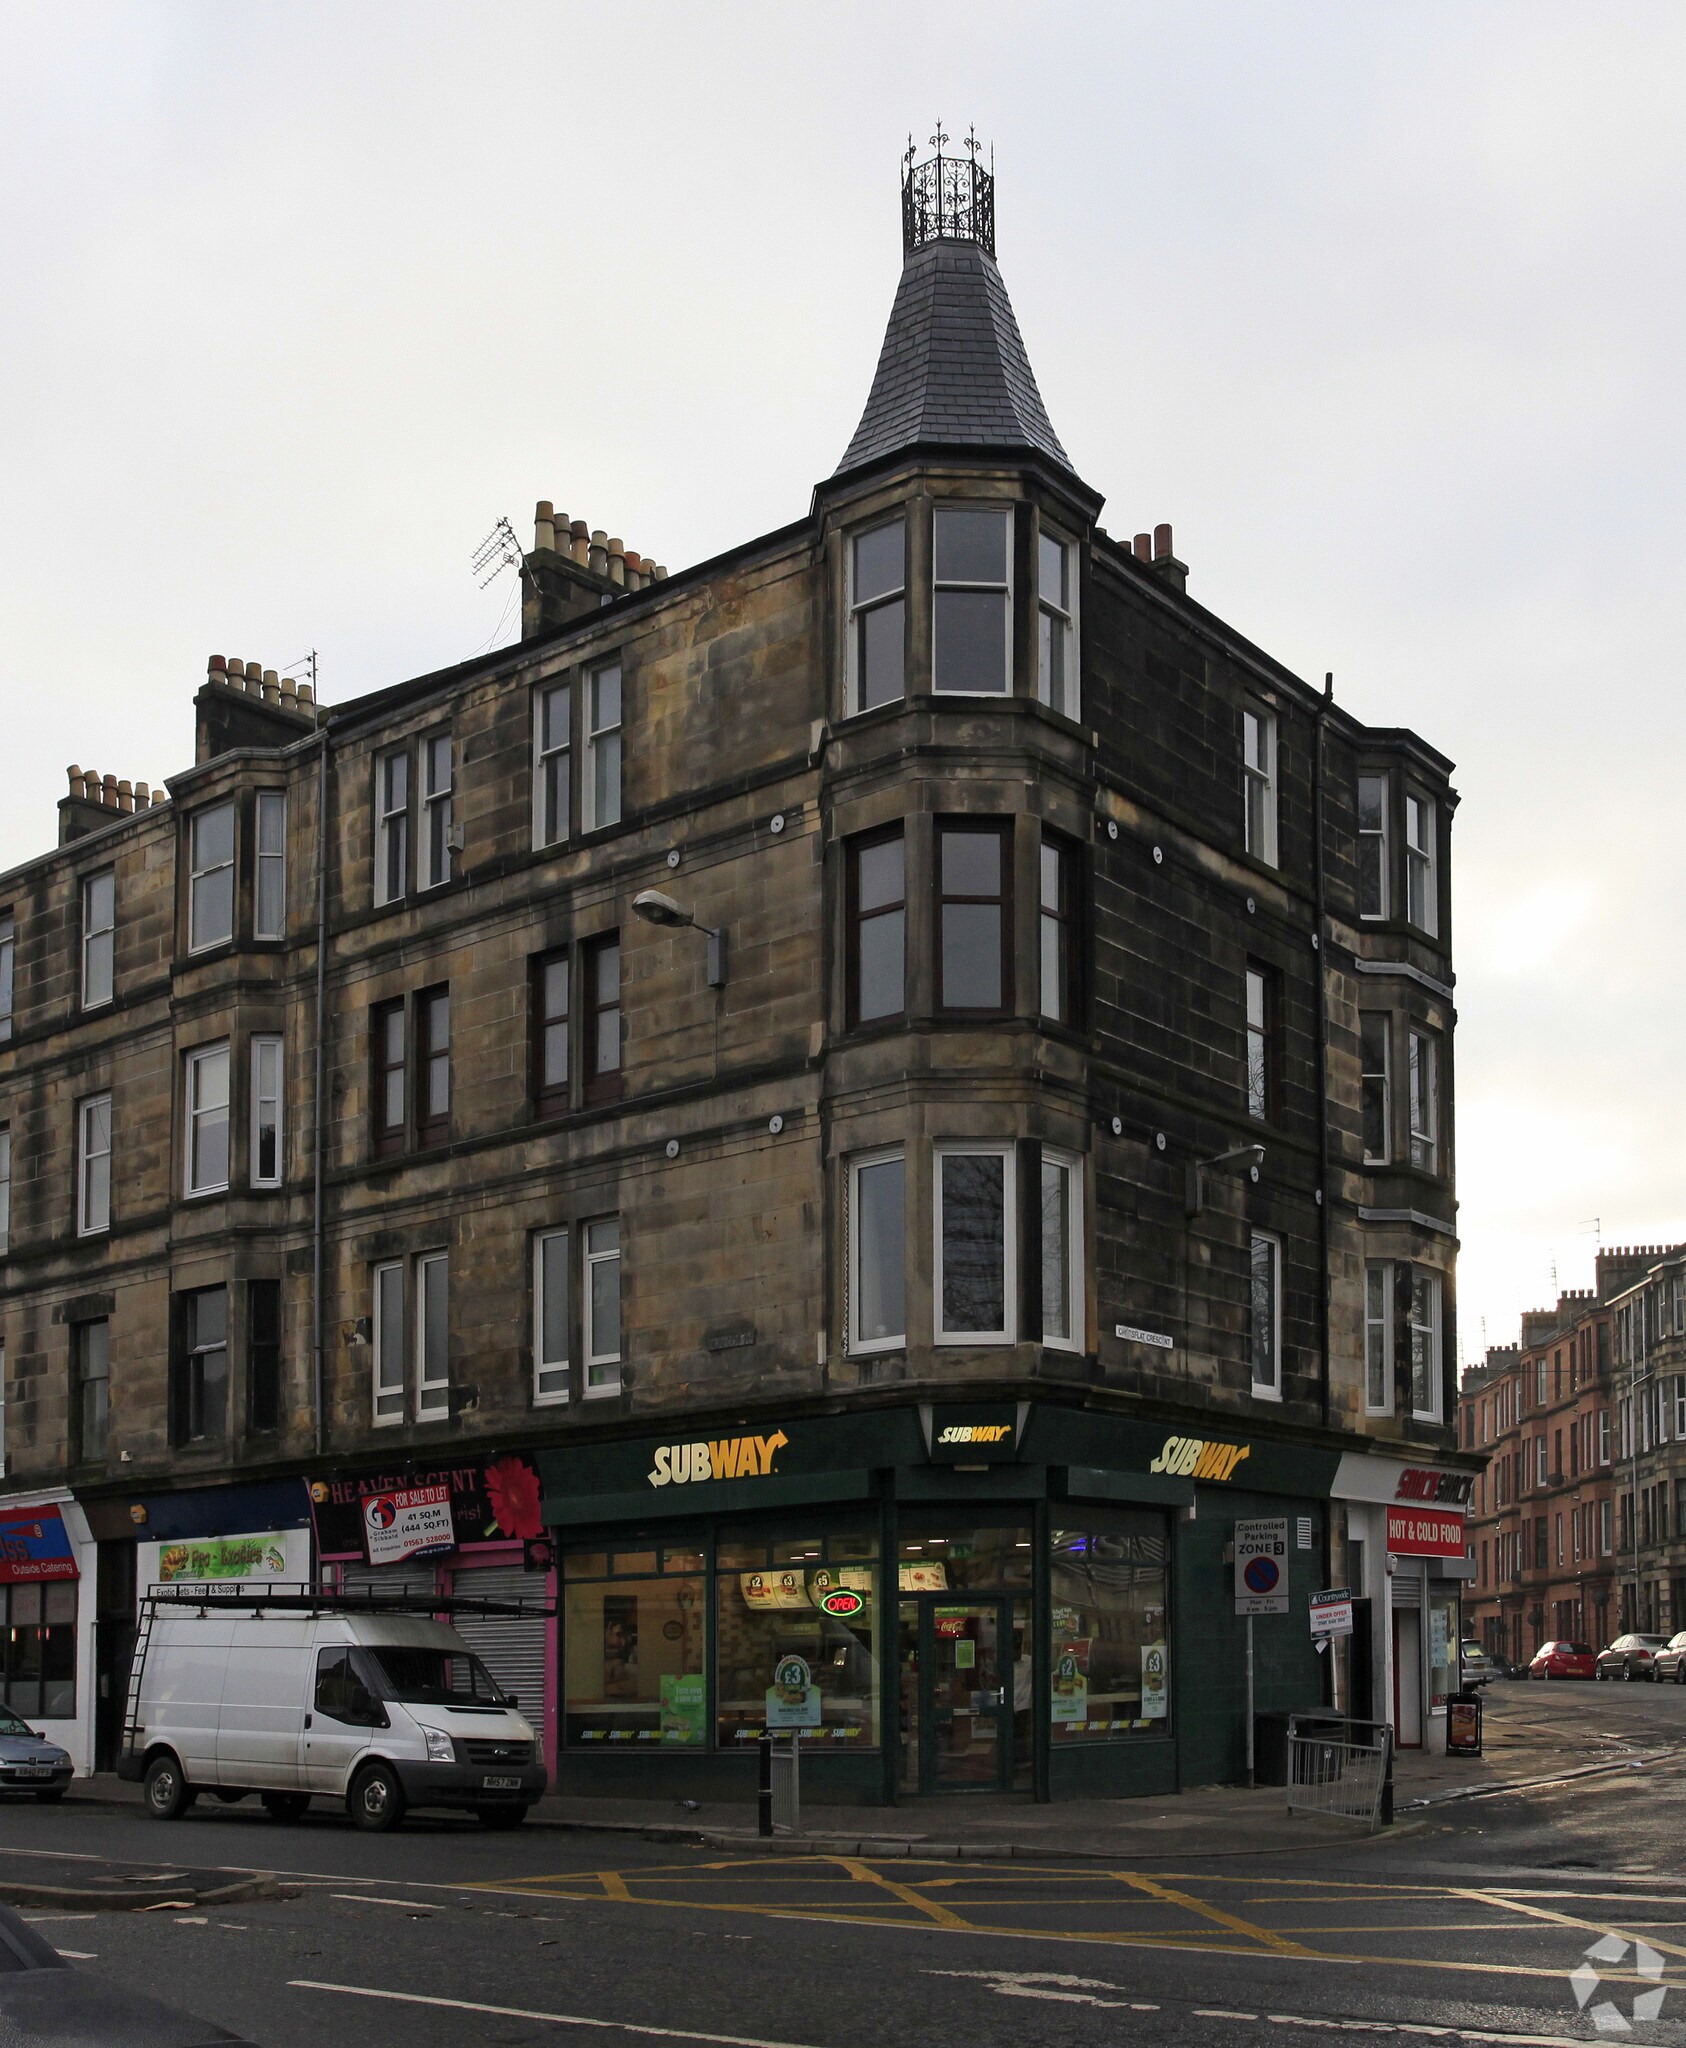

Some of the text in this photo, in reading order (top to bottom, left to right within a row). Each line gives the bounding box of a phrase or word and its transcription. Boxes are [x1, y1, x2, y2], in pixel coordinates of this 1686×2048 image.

[938, 1425, 1012, 1443] SUBWAY
[647, 1429, 788, 1488] SUBWAY
[1151, 1436, 1250, 1481] SUBWAY
[331, 1469, 476, 1504] HEAVEN SCENT
[395, 1492, 408, 1507] FOR
[436, 1486, 446, 1500] LET
[408, 1509, 441, 1521] 41 SQ.M
[455, 1504, 481, 1520] rist
[373, 1528, 397, 1536] Graham
[401, 1519, 449, 1534] (444 SQ.FT)
[1238, 1521, 1284, 1531] Controlled
[1389, 1519, 1461, 1544] HOT & COLD FOOD
[374, 1533, 398, 1542] Sibbald
[380, 1544, 401, 1552] Enquiries
[403, 1538, 424, 1547] 01563
[426, 1533, 450, 1543] 528000
[1245, 1533, 1278, 1541] Parking
[1239, 1542, 1283, 1554] ZONE 3
[191, 1549, 210, 1567] Pro
[12, 1562, 72, 1575] Outside Catering
[751, 1576, 761, 1588] £2
[783, 1575, 793, 1586] £3
[818, 1575, 828, 1586] £5
[157, 1587, 175, 1596] Exotic
[179, 1587, 189, 1596] ets
[195, 1586, 206, 1595] Fee
[1318, 1590, 1349, 1602] Countrywide
[827, 1597, 857, 1611] OPEN
[1062, 1659, 1073, 1675] £2
[1149, 1653, 1160, 1672] £3
[785, 1665, 800, 1684] £3
[831, 1728, 862, 1738] SUBWAY
